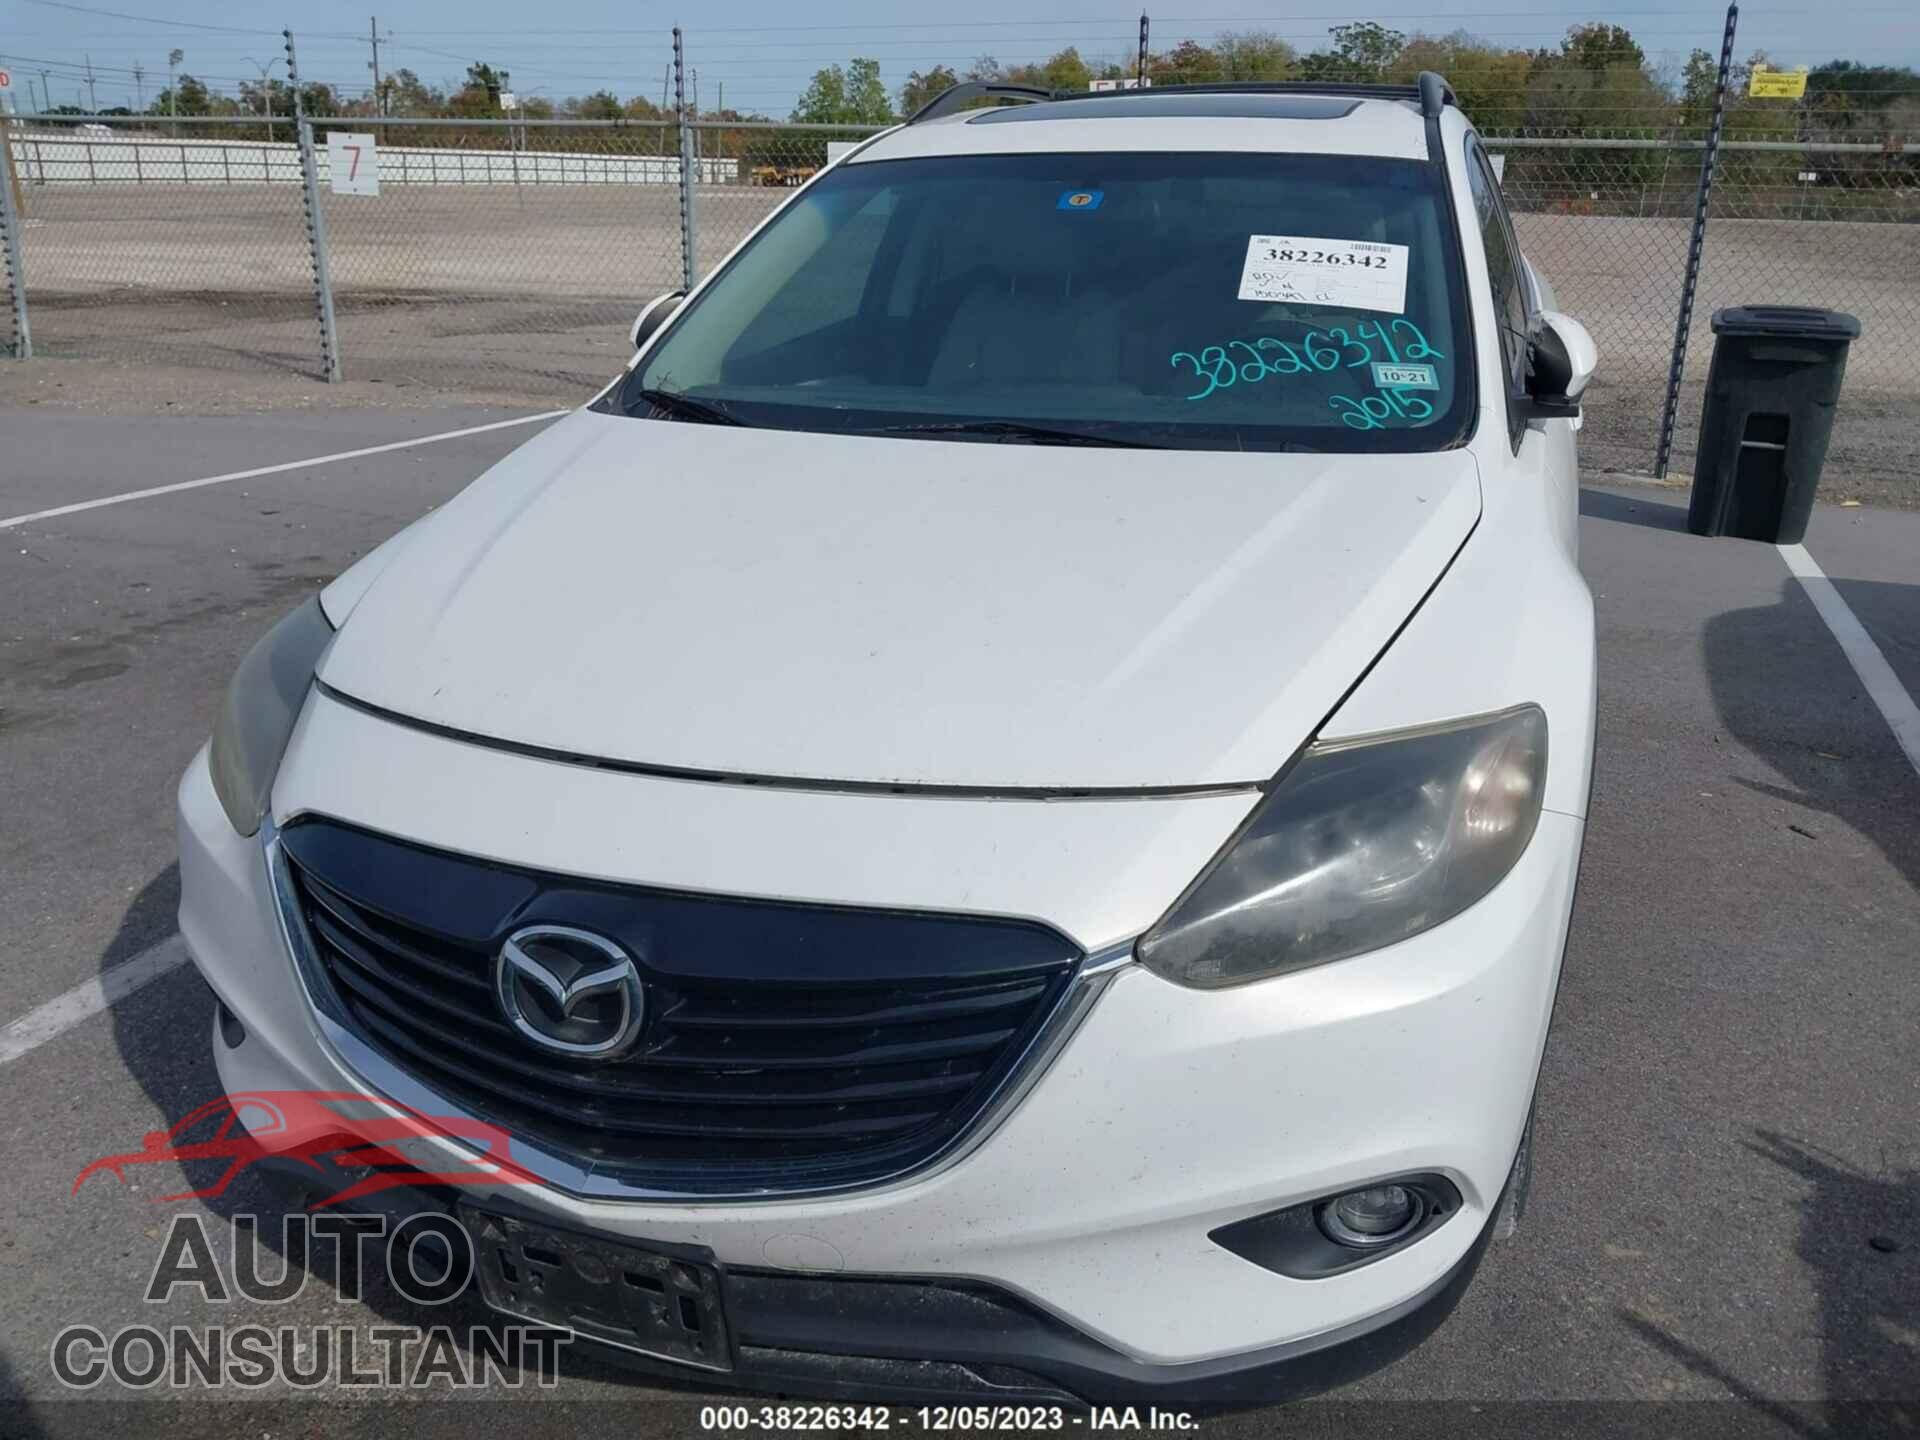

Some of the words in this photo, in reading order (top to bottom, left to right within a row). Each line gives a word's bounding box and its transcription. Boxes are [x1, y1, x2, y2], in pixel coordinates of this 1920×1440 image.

[342, 145, 360, 181] 7
[1264, 248, 1388, 270] 38226342
[1171, 319, 1444, 400] 38226342
[1328, 386, 1433, 430] 2015
